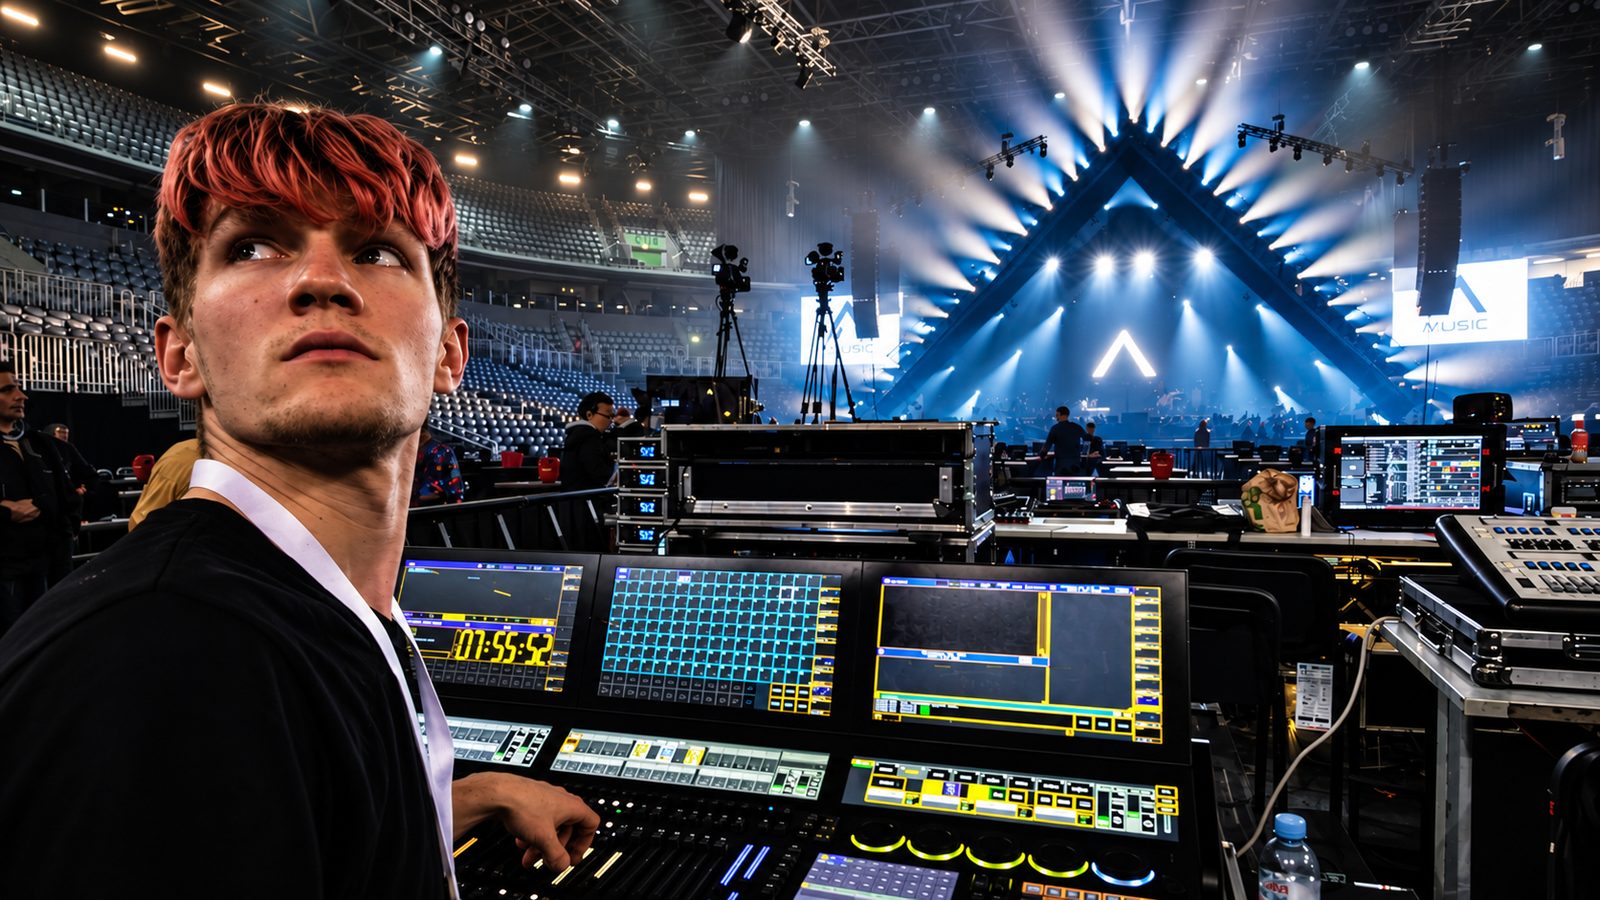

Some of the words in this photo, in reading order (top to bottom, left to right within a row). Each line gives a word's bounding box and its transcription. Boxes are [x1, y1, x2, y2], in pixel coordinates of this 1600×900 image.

[1422, 318, 1487, 332] MUSIC
[832, 344, 873, 353] USIC
[455, 629, 553, 666] 07:55:52
